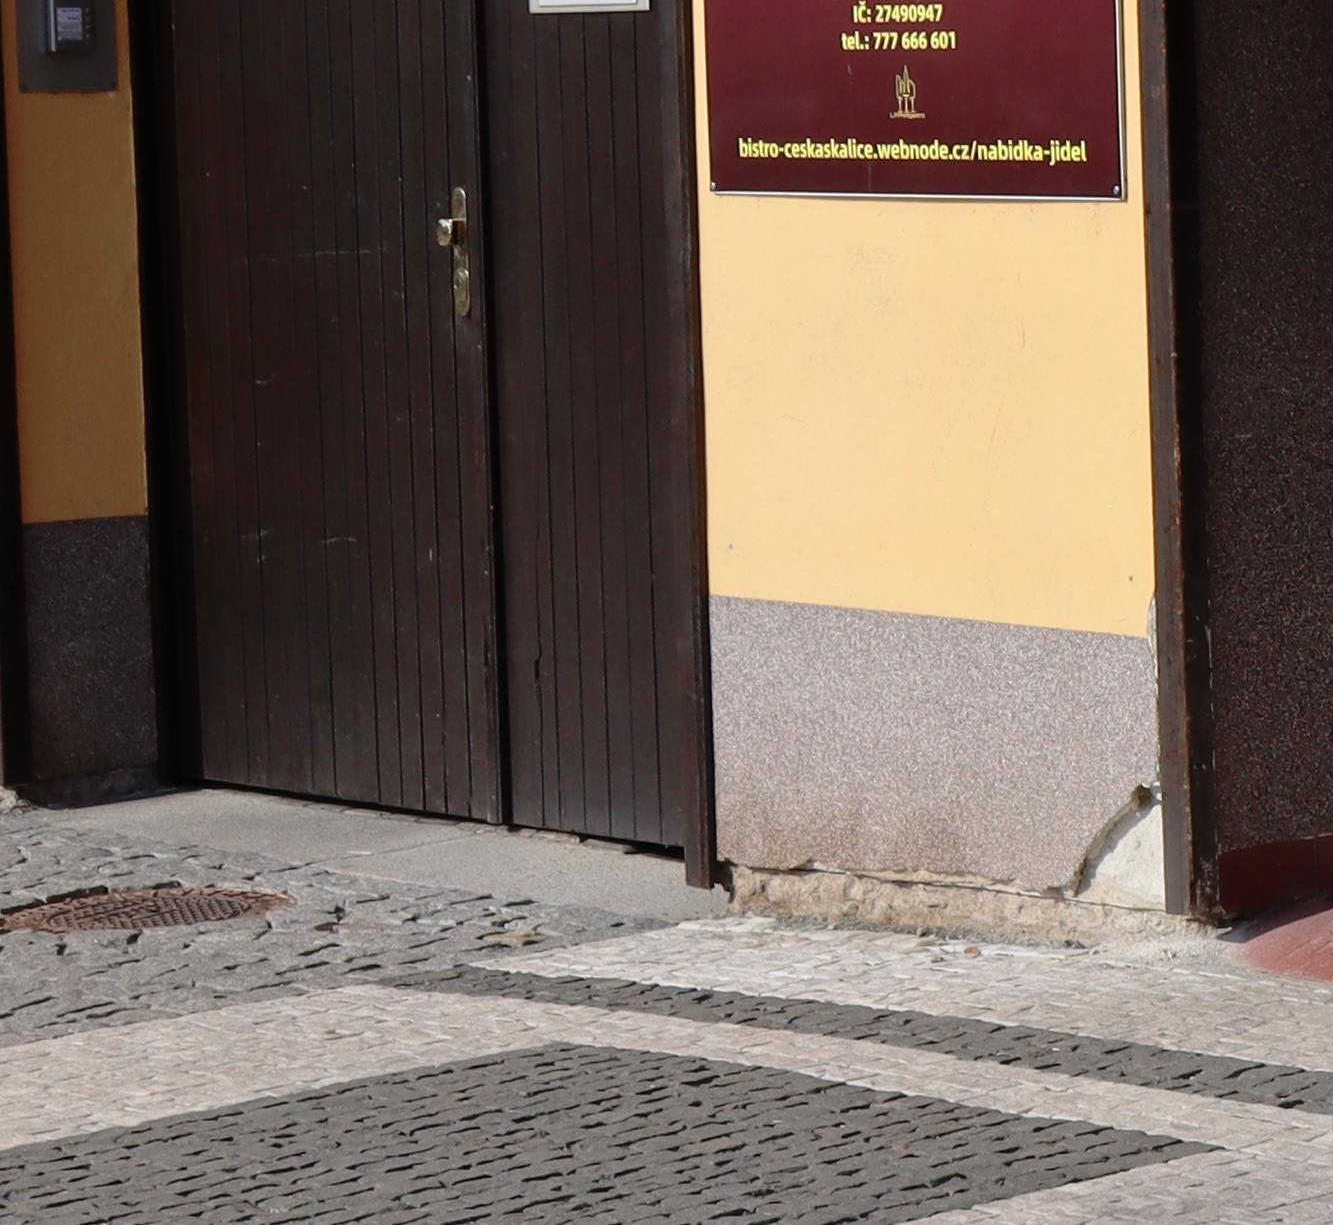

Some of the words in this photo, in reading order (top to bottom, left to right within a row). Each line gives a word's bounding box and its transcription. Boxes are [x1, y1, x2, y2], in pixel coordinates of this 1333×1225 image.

[853, 0, 872, 23] IČ:
[875, 3, 943, 23] 27490947
[841, 30, 870, 50] tel.:
[872, 31, 898, 50] 777
[901, 31, 928, 50] 666
[930, 31, 956, 50] 601
[738, 137, 1087, 166] bistro-ceskaskalice.webnode.cz/nabidka-jidel
